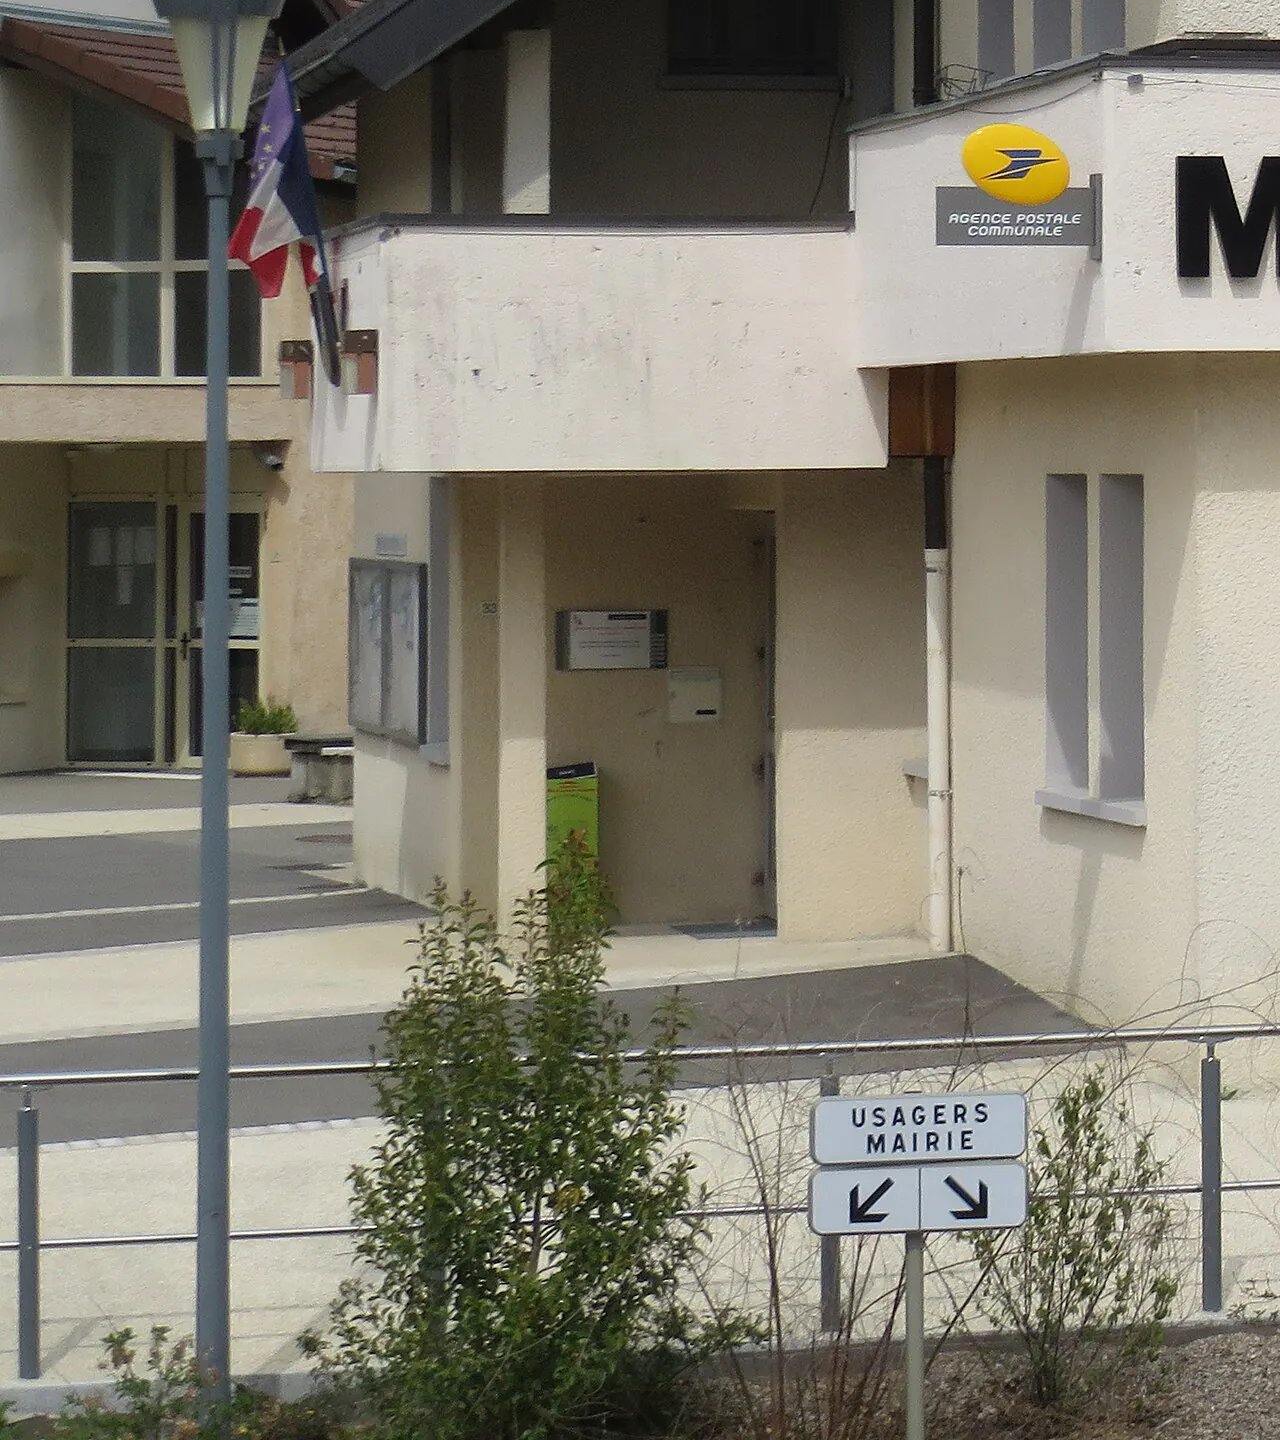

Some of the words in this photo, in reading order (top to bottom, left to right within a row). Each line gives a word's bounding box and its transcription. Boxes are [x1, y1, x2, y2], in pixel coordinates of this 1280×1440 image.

[949, 213, 1012, 224] AGENCE
[1016, 213, 1082, 224] POSTALE
[968, 225, 1064, 237] COMMUNALE
[851, 1102, 989, 1128] USAGERS
[866, 1129, 975, 1155] MAIRIE
